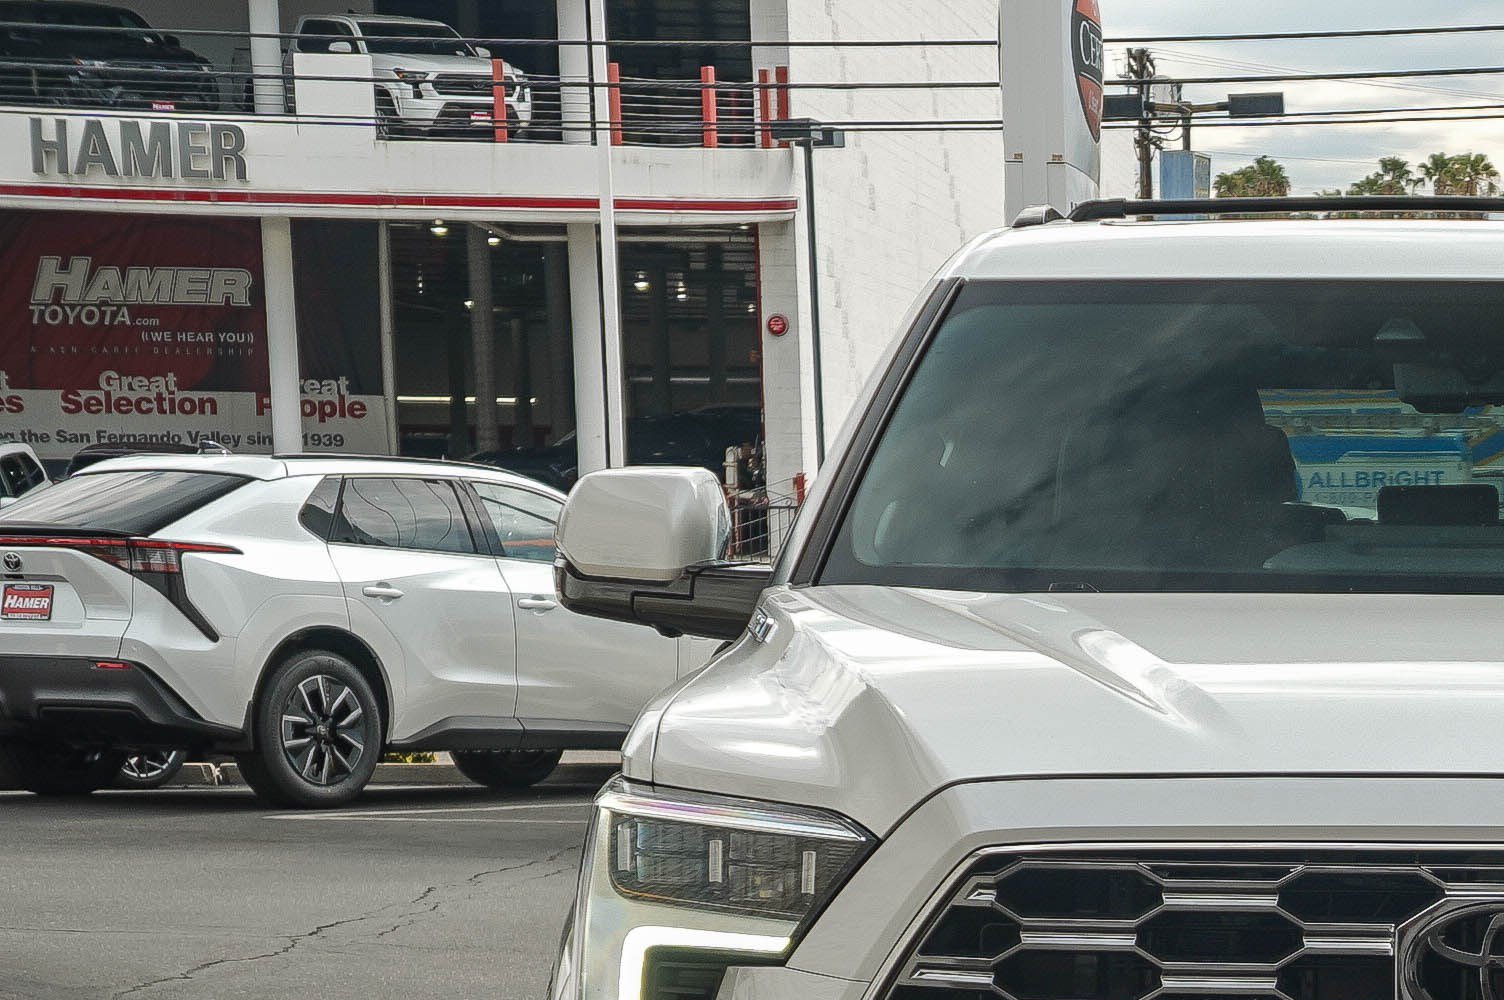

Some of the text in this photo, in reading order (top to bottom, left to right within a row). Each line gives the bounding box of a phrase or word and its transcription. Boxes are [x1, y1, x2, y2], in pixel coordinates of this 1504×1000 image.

[29, 117, 248, 181] HAMER
[30, 256, 252, 305] HAMER
[177, 332, 214, 342] HEAR
[100, 370, 349, 394] Great eat
[61, 389, 367, 423] Selection Pople
[20, 429, 50, 443] the
[56, 429, 90, 444] San
[96, 430, 181, 444] Fernando
[187, 431, 241, 448] Valley
[247, 431, 273, 446] sin
[302, 433, 345, 447] 1939
[4, 595, 50, 609] HAMER
